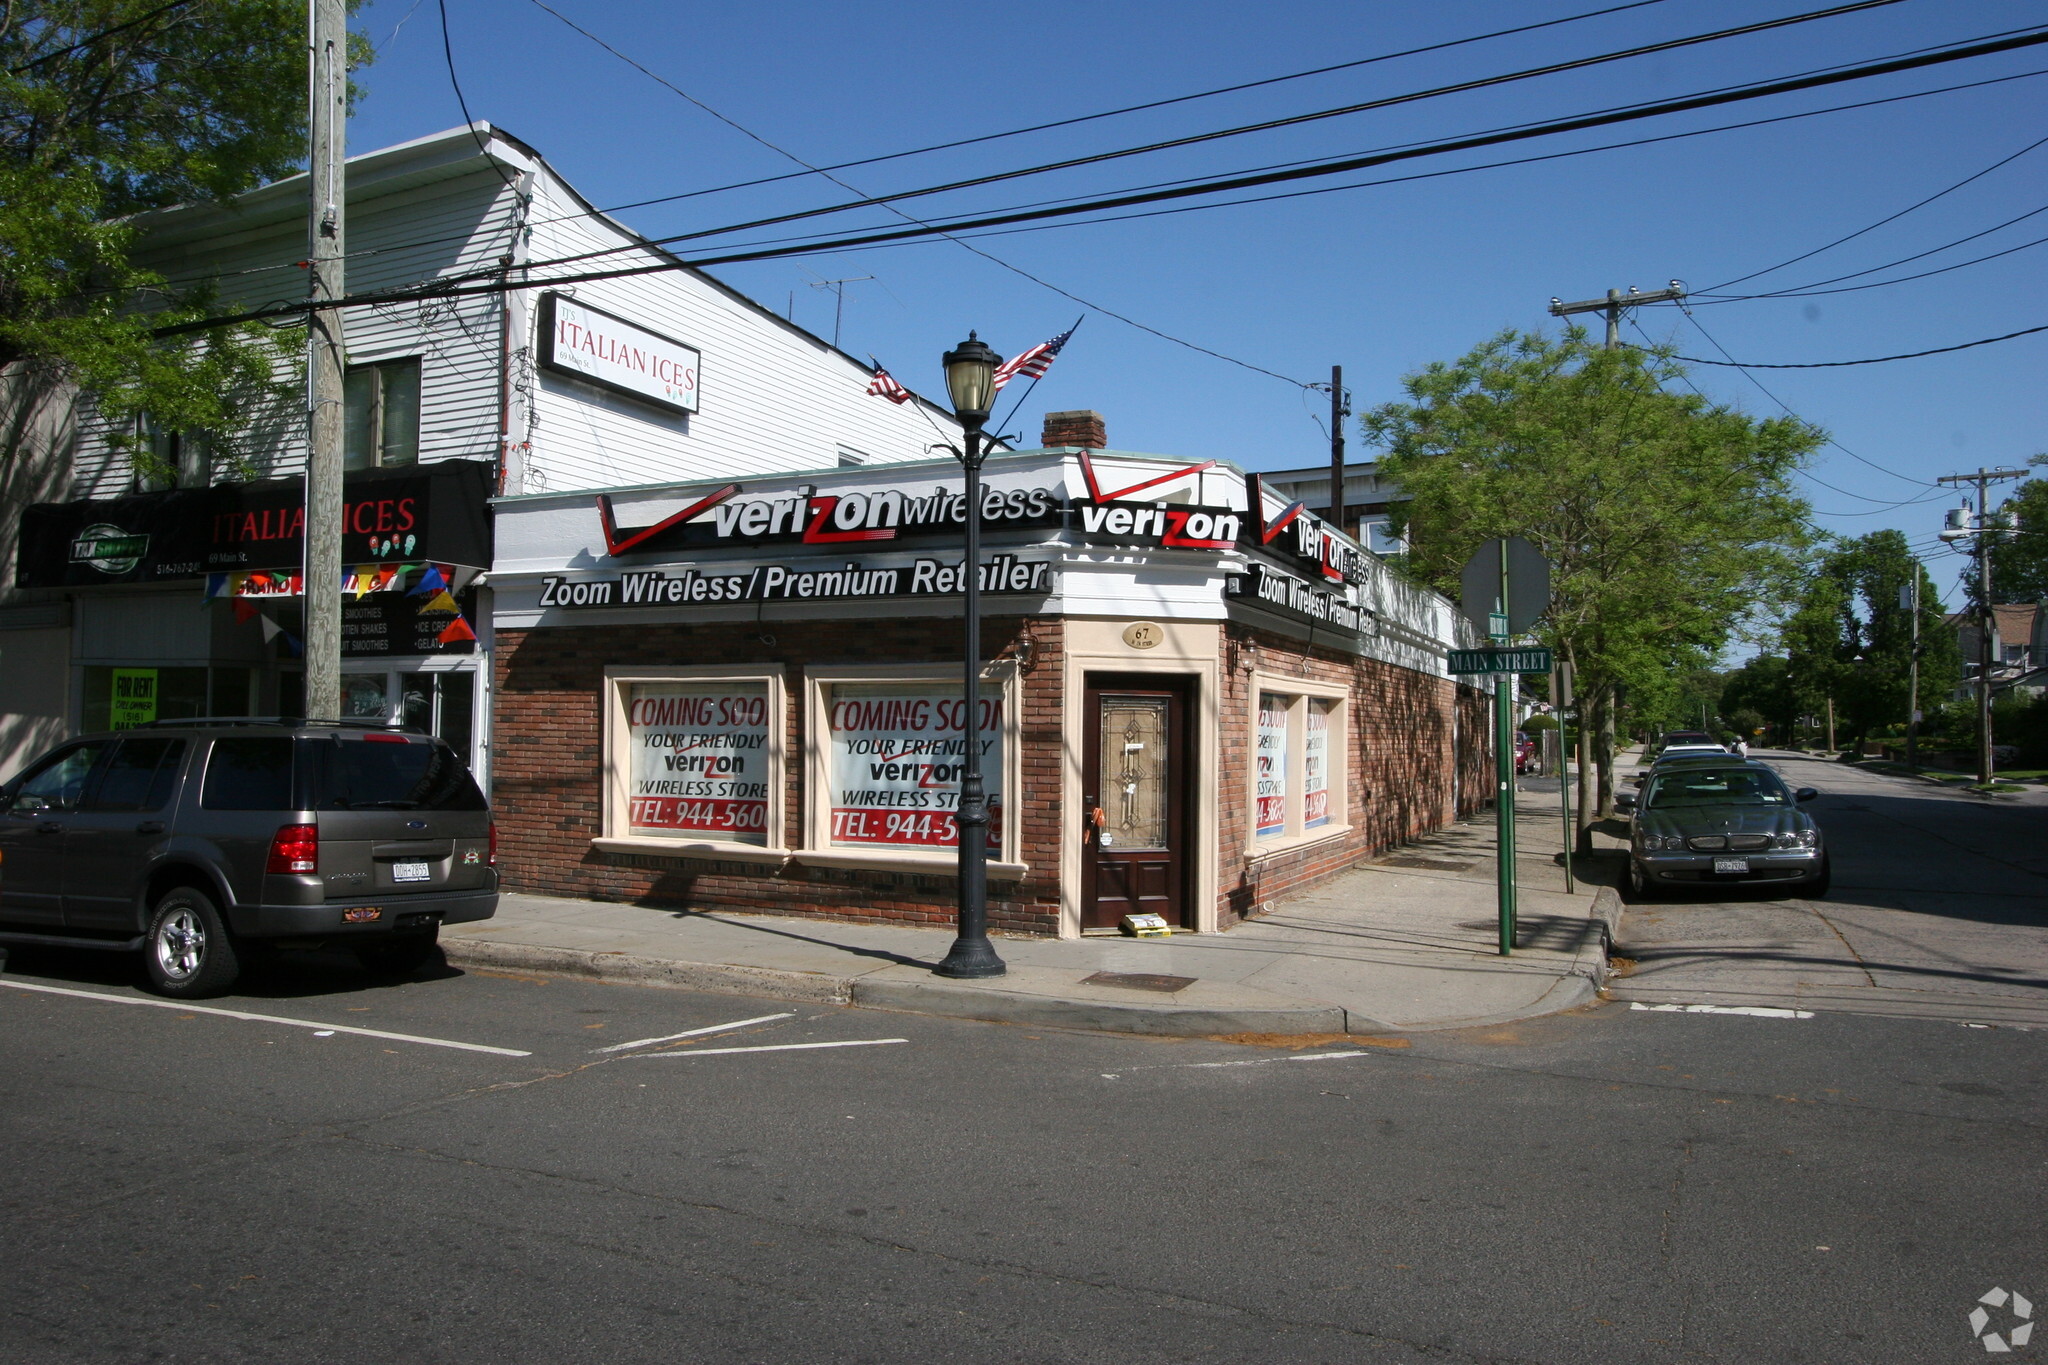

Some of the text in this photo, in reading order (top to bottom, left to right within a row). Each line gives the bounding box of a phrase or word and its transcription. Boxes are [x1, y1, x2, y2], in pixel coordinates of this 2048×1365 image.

[561, 306, 576, 321] TJ'S
[559, 319, 694, 391] ITALIAN ICES
[559, 351, 568, 360] 69
[212, 498, 416, 544] ITALIA ICES
[715, 484, 903, 544] verizon
[1082, 502, 1241, 549] verizon
[208, 552, 219, 564] 69
[219, 551, 237, 563] Main
[1297, 520, 1344, 582] verizon
[157, 561, 201, 575] 516-767-24
[540, 576, 612, 606] Zoom
[622, 570, 742, 602] Wireless
[763, 563, 897, 598] Premium
[1258, 563, 1286, 605] Zoom
[345, 606, 382, 619] SMOOTHIES
[361, 622, 388, 635] SHAKES
[432, 620, 453, 632] CREA
[1135, 628, 1150, 640] 67
[352, 639, 389, 652] SMOOTHIES
[1451, 652, 1546, 671] MAIN STREET
[117, 676, 154, 698] FOR RENT
[631, 697, 769, 727] COMING SOO
[831, 700, 930, 732] COMING
[644, 733, 767, 749] YOUR FRIENDLY
[847, 739, 994, 756] YOUR FRIENDY
[664, 755, 745, 778] verizon
[639, 780, 768, 799] WIRELESS STORE
[842, 790, 930, 808] WIRELESS
[631, 800, 769, 828] TEL: 944-560
[833, 812, 880, 838] TEL:
